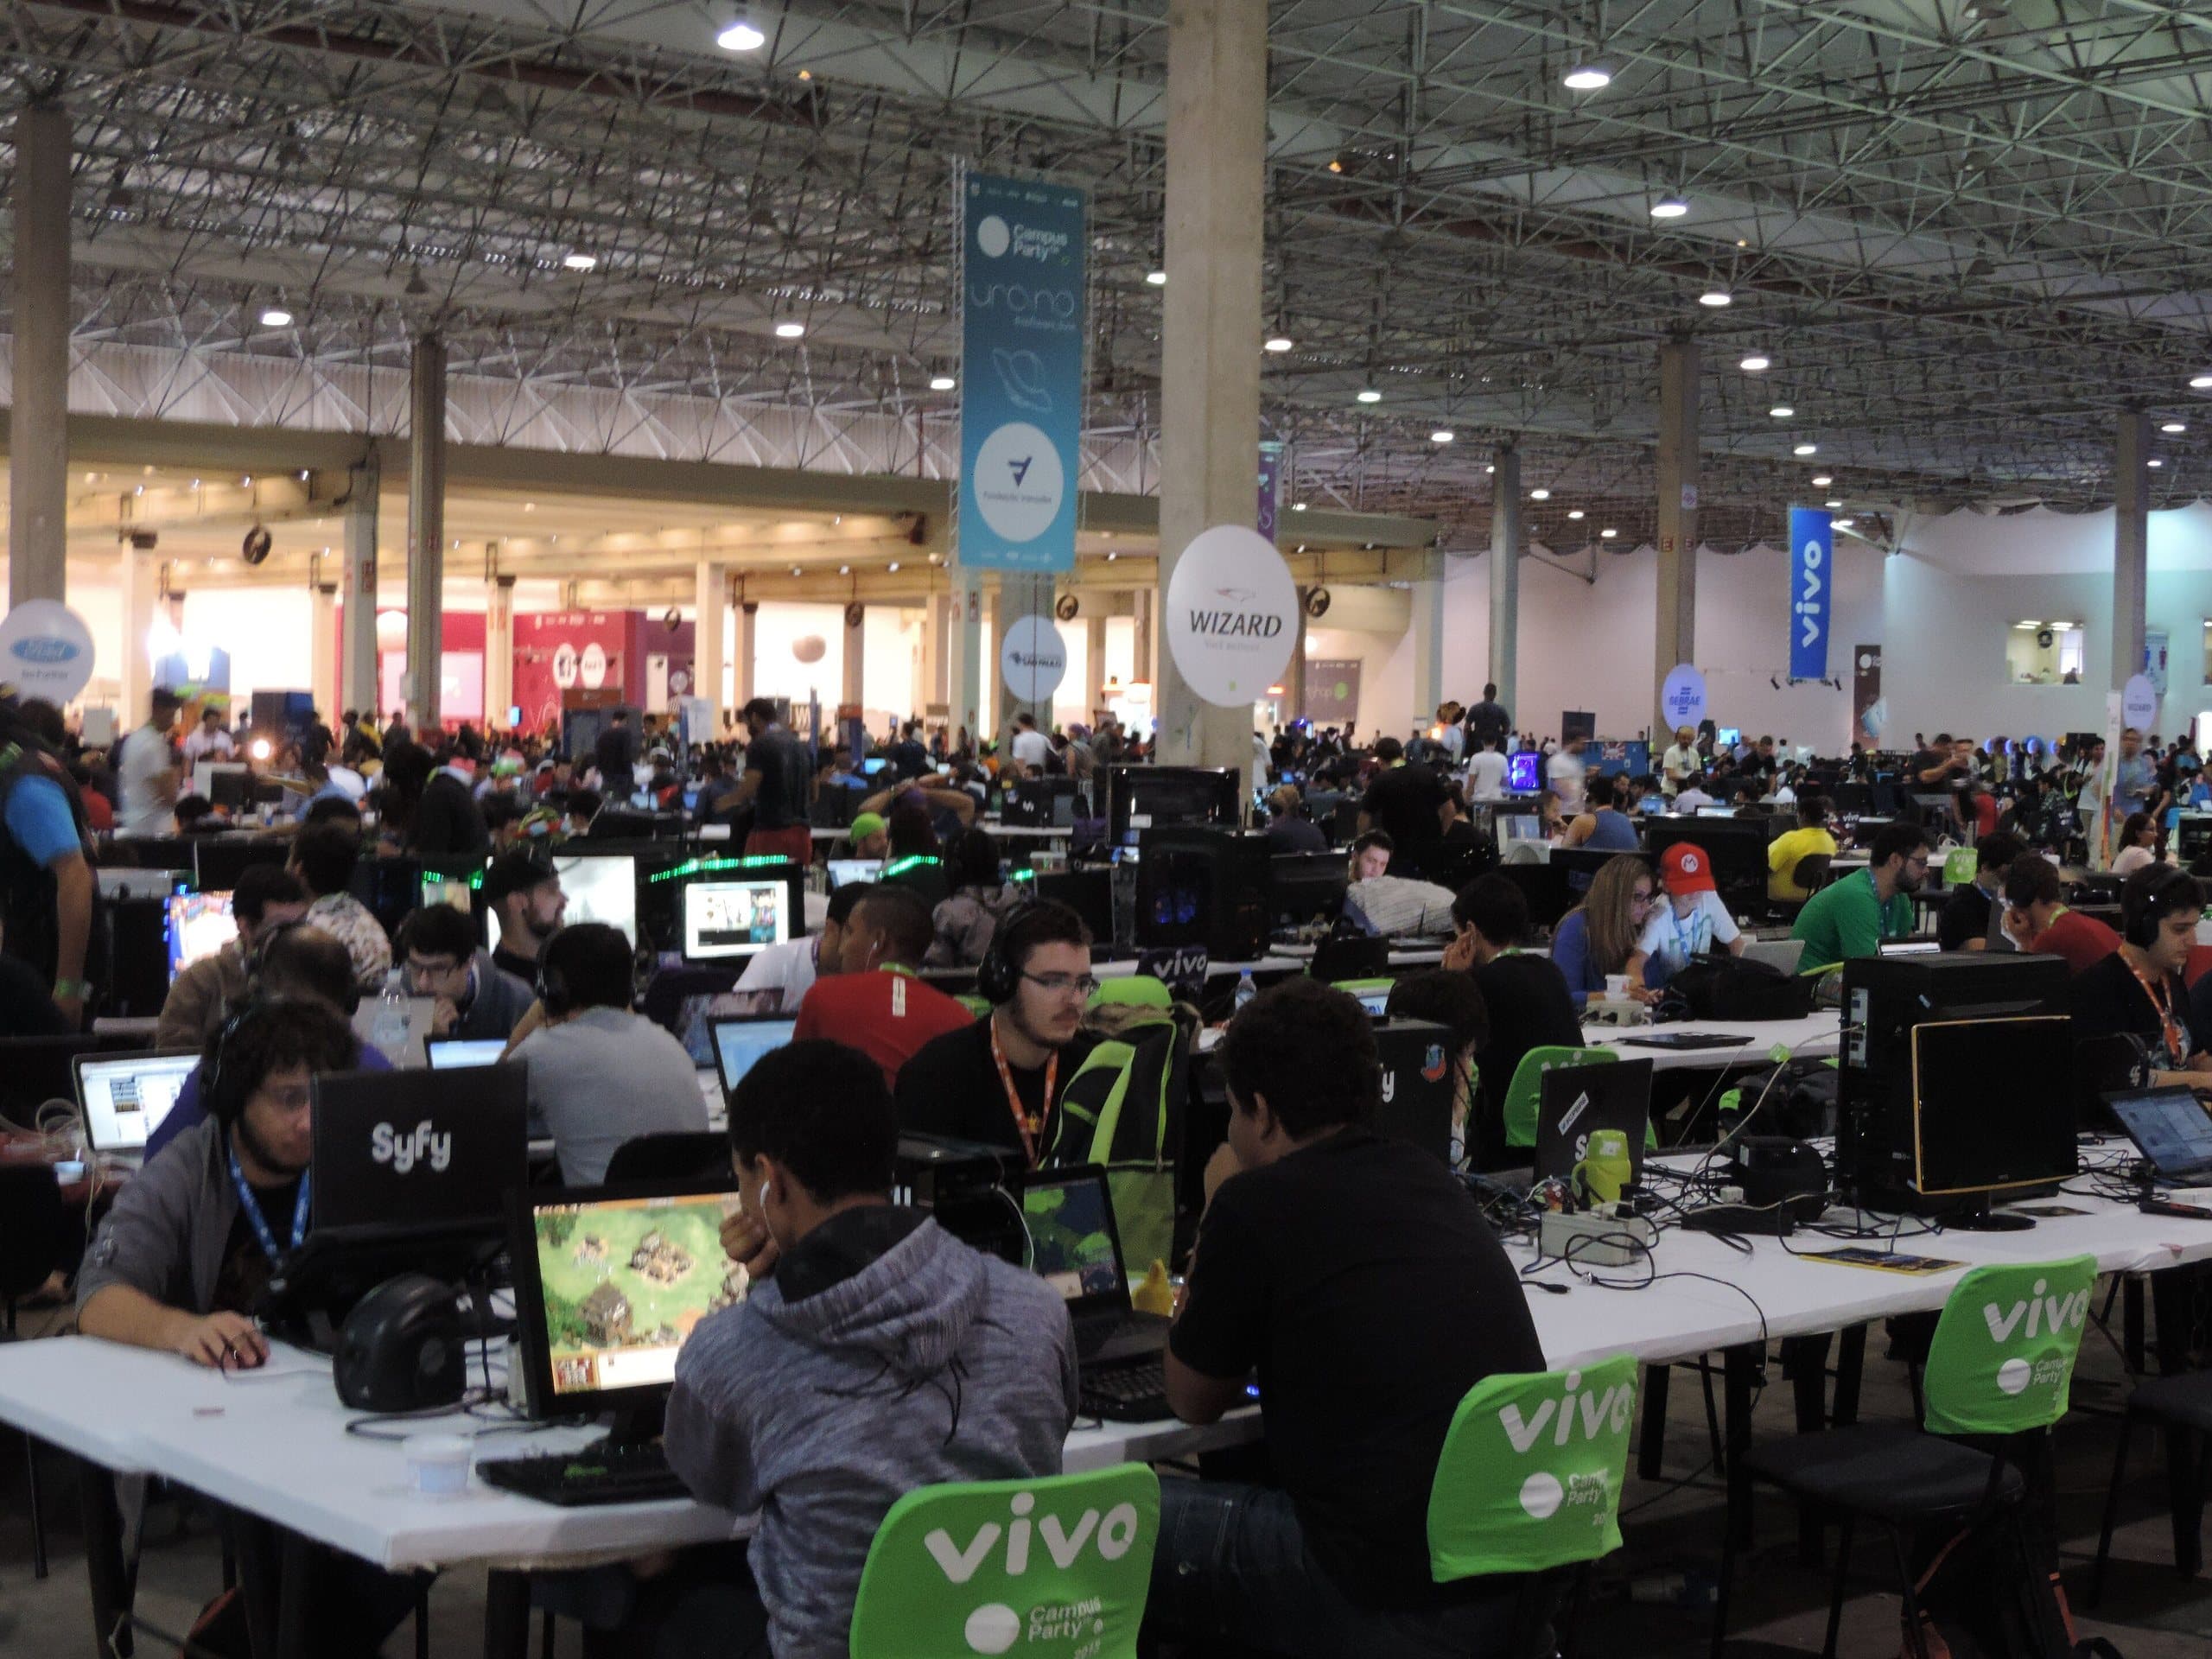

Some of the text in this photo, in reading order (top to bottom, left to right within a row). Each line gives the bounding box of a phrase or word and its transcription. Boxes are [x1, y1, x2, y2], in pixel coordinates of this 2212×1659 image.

[1796, 539, 1821, 648] vivo
[1190, 610, 1282, 638] WIZARD
[1153, 950, 1207, 978] vivo
[372, 1120, 451, 1174] Syfy
[1983, 1278, 2088, 1342] vivo
[1498, 1370, 1631, 1452] vivo
[924, 1492, 1138, 1583] vivo
[1028, 1619, 1082, 1642] Party
[1029, 1596, 1102, 1624] Campus
